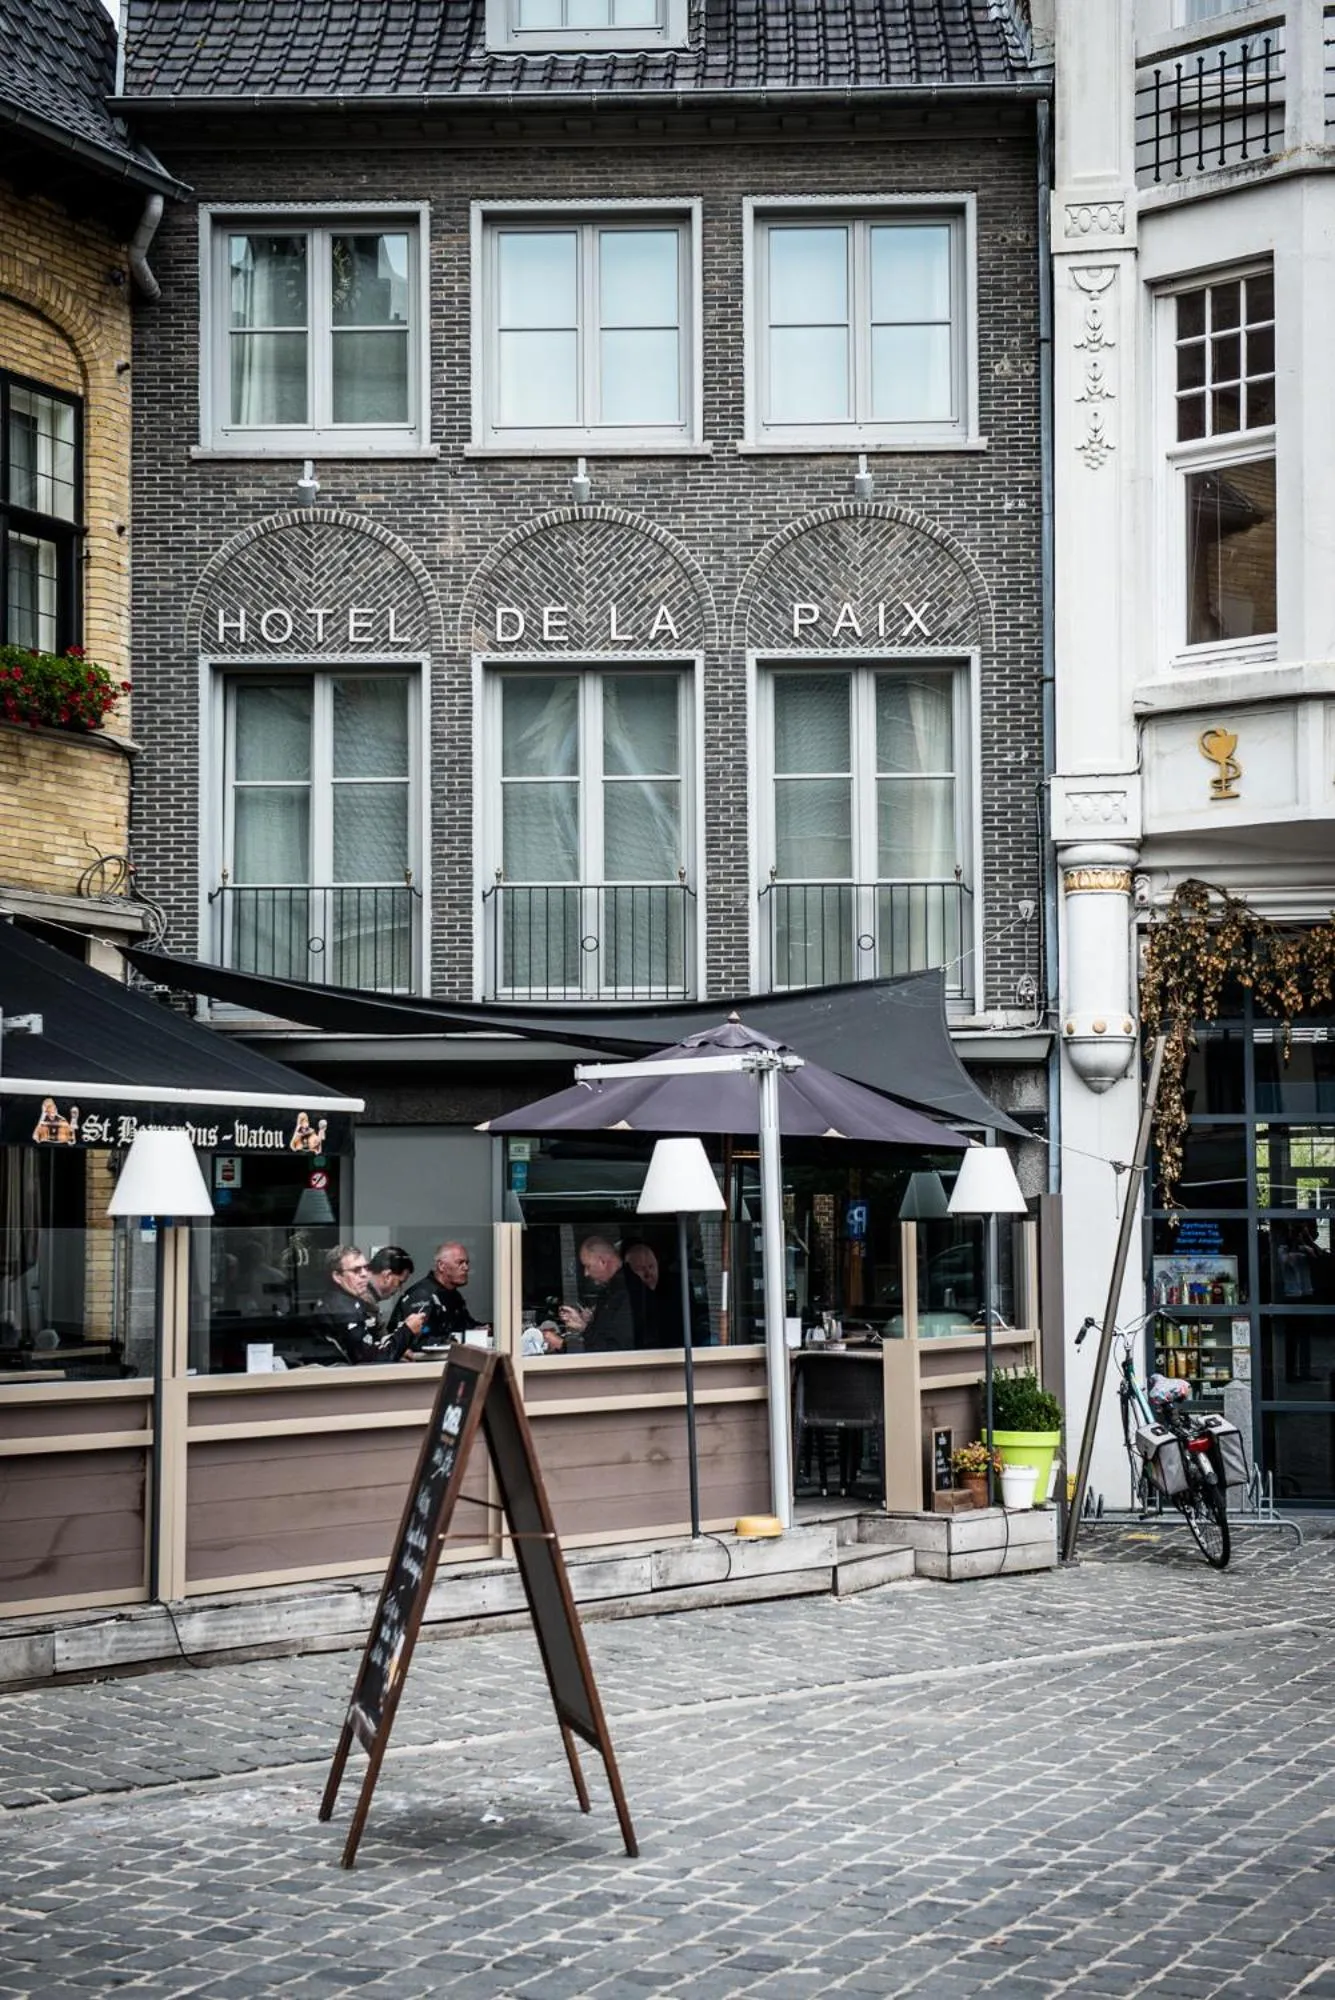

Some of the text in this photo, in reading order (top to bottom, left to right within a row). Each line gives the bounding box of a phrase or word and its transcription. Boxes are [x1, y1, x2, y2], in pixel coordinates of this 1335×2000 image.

[218, 601, 932, 643] HOTEL DE LA PAIX
[81, 1114, 115, 1143] St.
